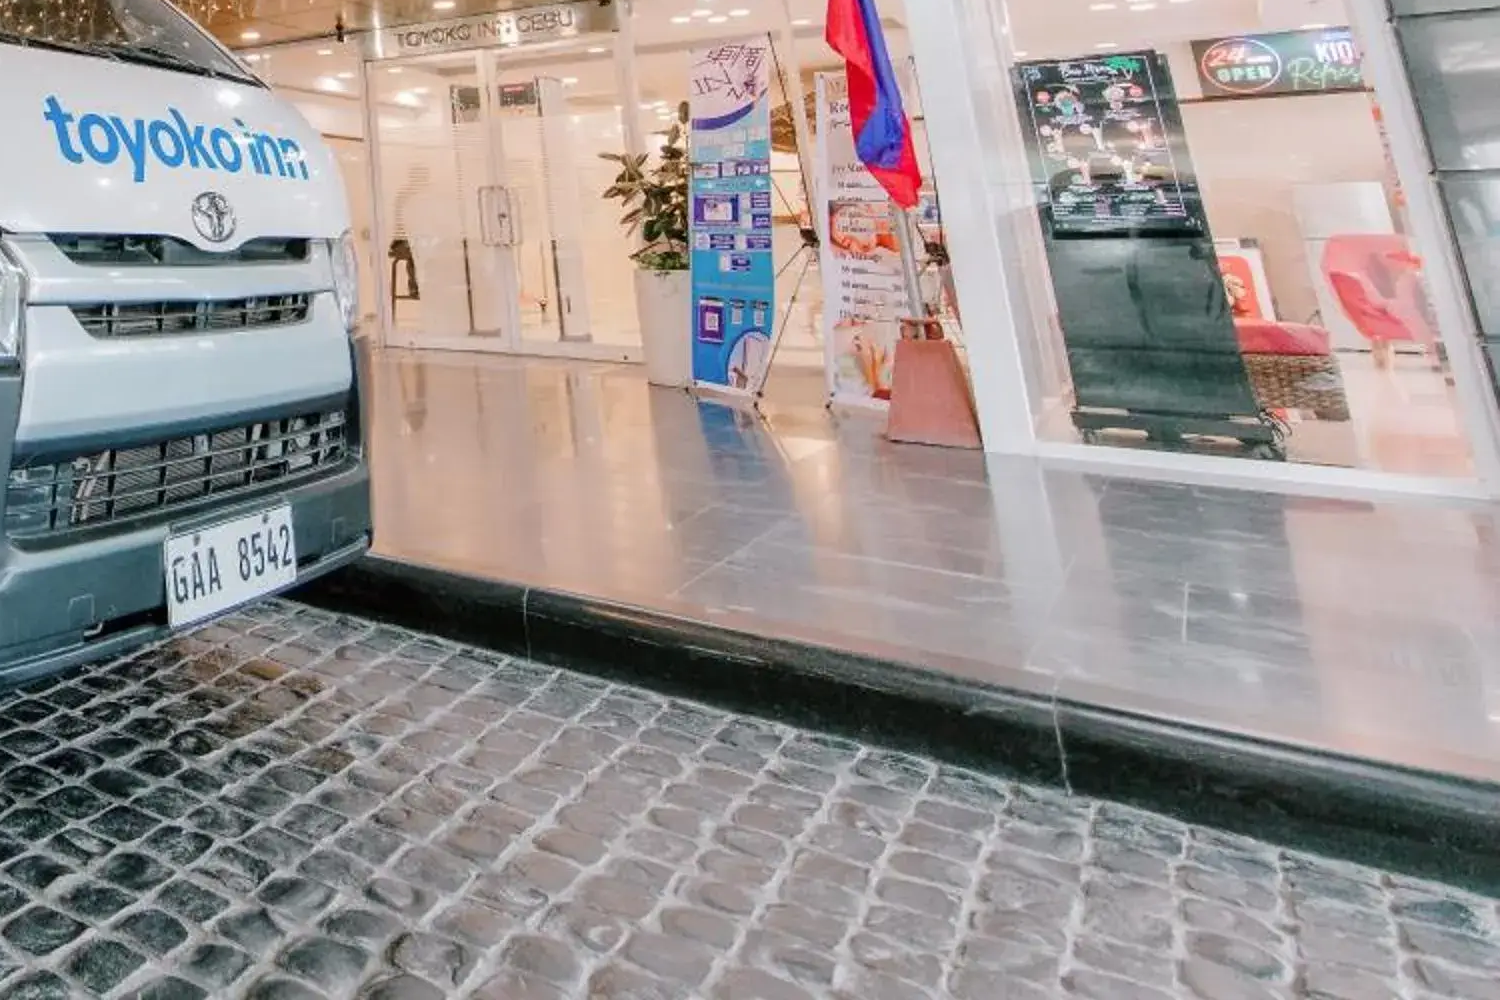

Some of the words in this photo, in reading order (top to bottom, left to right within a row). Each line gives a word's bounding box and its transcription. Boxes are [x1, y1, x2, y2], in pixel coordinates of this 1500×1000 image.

[394, 23, 471, 48] TOYOKO
[1209, 45, 1245, 68] 24
[1216, 65, 1272, 83] OPEN
[44, 95, 243, 183] toyoko
[173, 547, 222, 603] GAA
[238, 523, 293, 581] 8542
